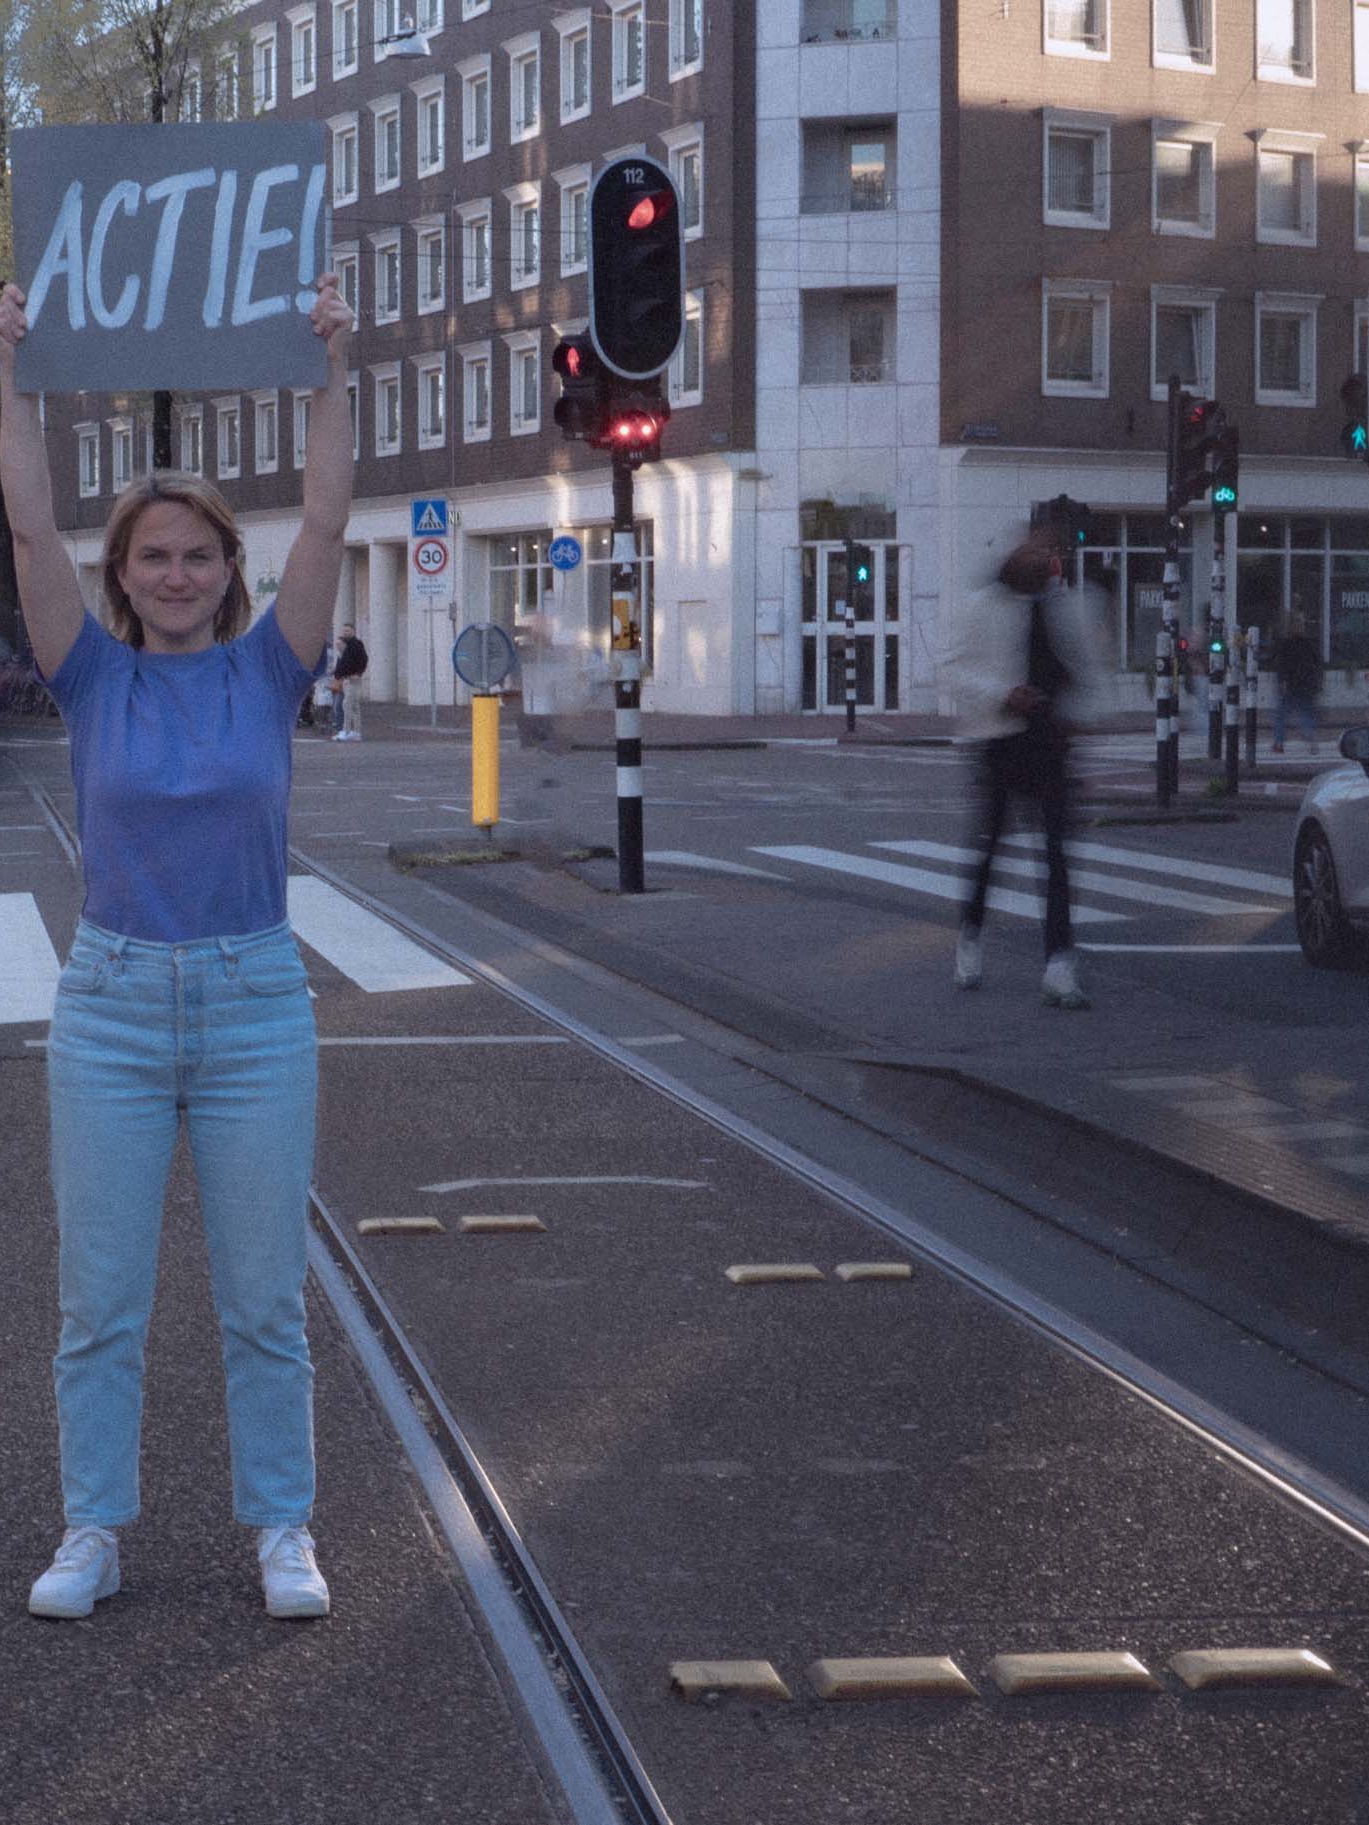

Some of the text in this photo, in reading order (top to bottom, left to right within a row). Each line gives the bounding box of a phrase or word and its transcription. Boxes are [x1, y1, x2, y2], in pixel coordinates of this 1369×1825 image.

[622, 168, 645, 184] 112
[24, 163, 327, 331] ACTIE!
[421, 550, 443, 564] 30
